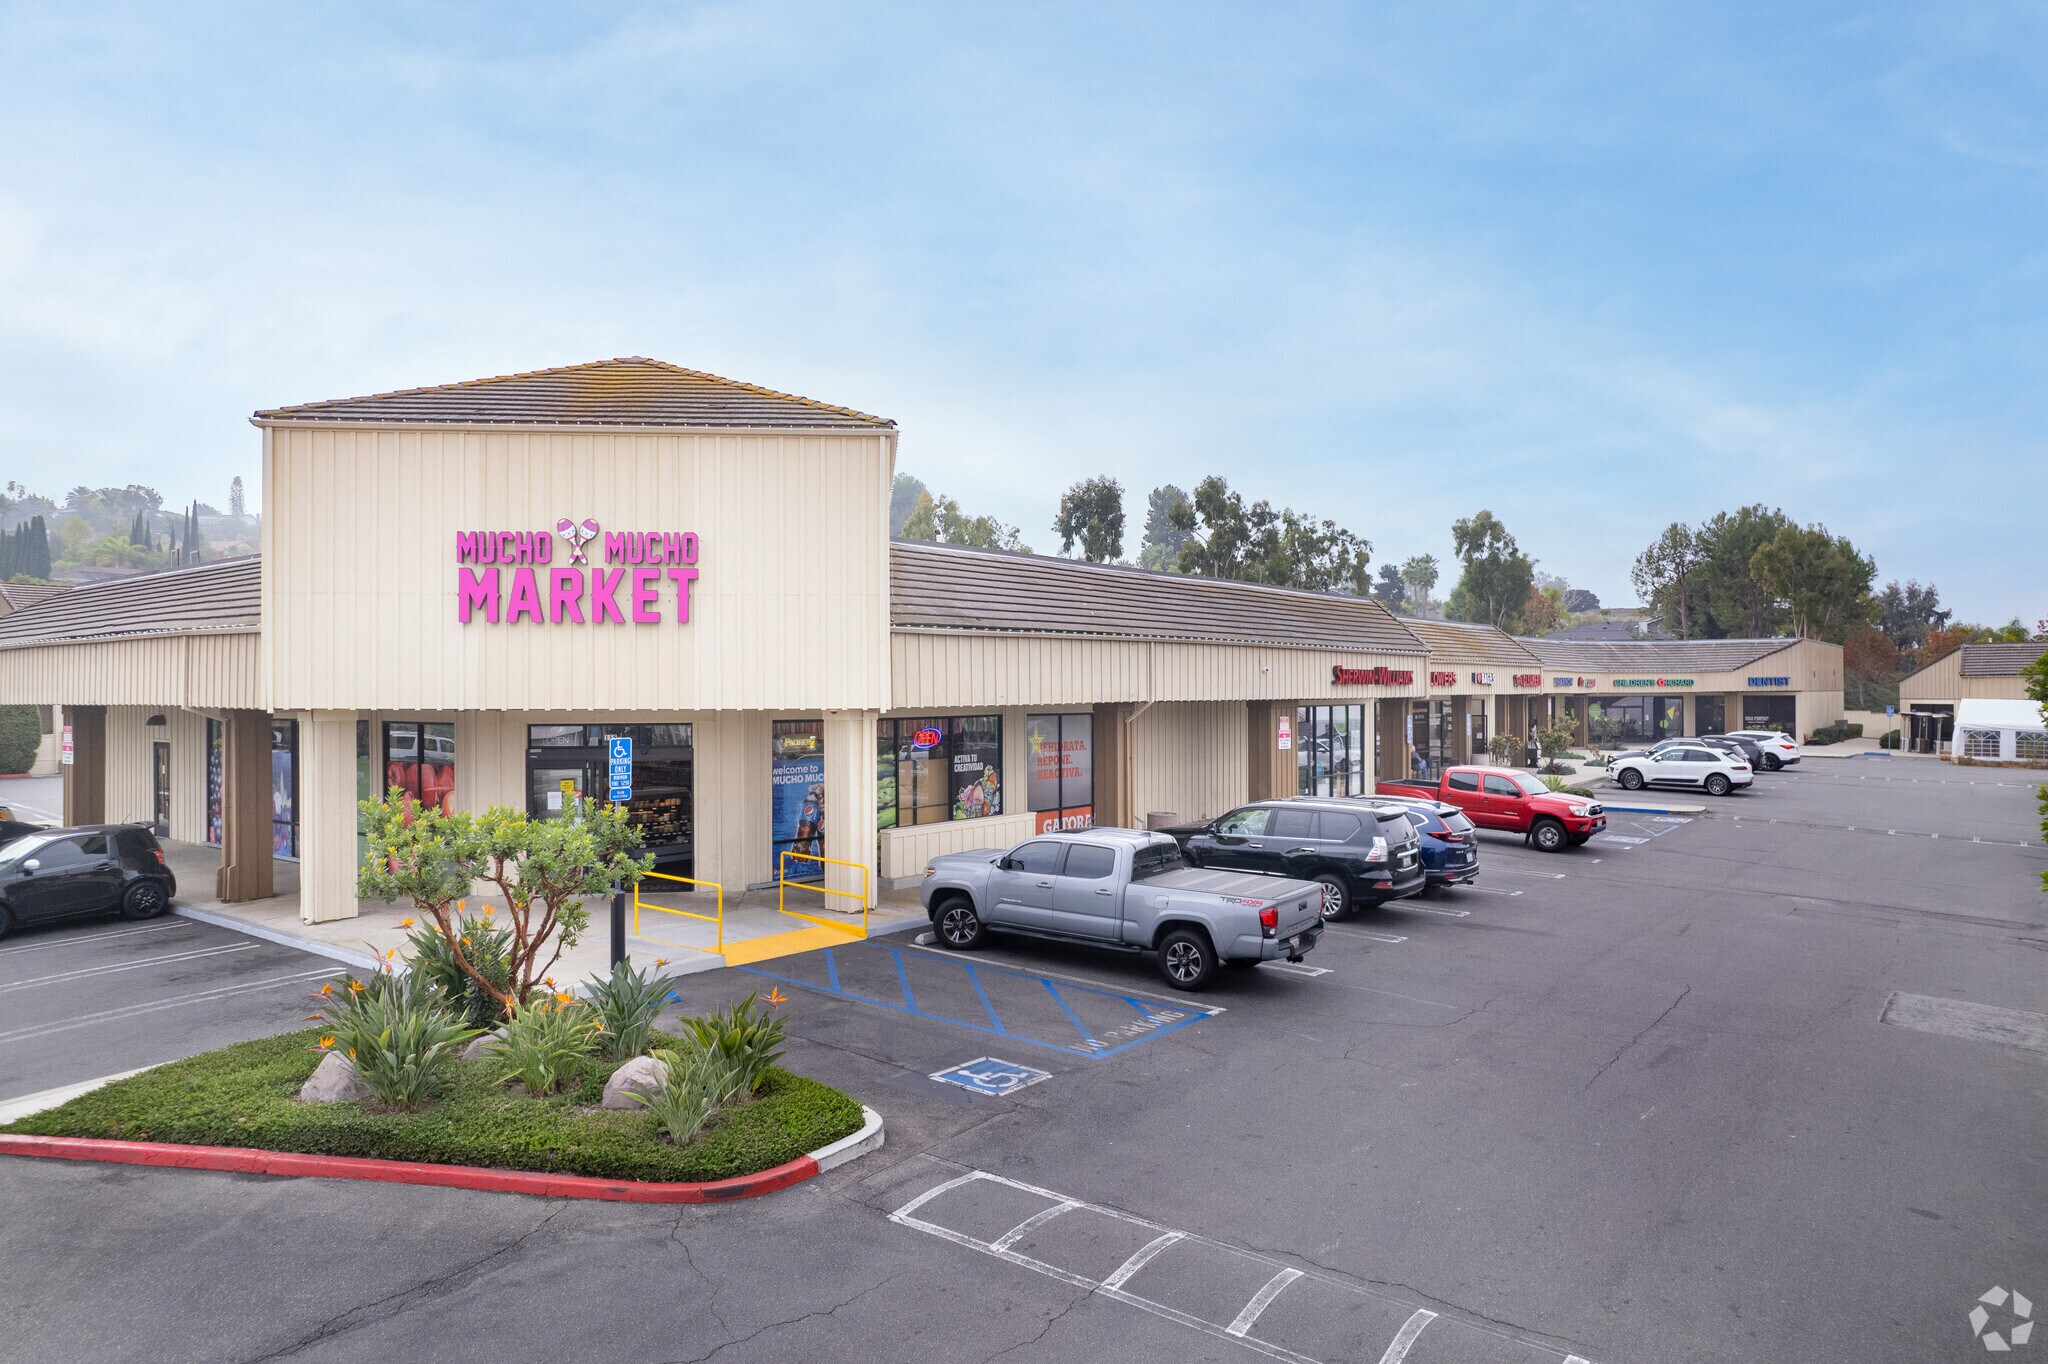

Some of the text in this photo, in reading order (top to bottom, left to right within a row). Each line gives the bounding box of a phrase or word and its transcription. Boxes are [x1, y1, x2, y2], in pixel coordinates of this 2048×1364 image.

[456, 531, 699, 564] MUCHO MUCHO
[458, 568, 699, 623] MARKET
[1331, 665, 1414, 685] SHERWIN-WILLIAMS
[1613, 679, 1655, 687] CHILDREN'S
[1748, 676, 1791, 686] DENTIST
[914, 730, 939, 745] OPEN
[954, 753, 978, 764] ACTIVA TU
[773, 764, 819, 775] welcome to
[954, 762, 984, 773] CREATIVIDAD
[772, 775, 803, 785] MUCHO
